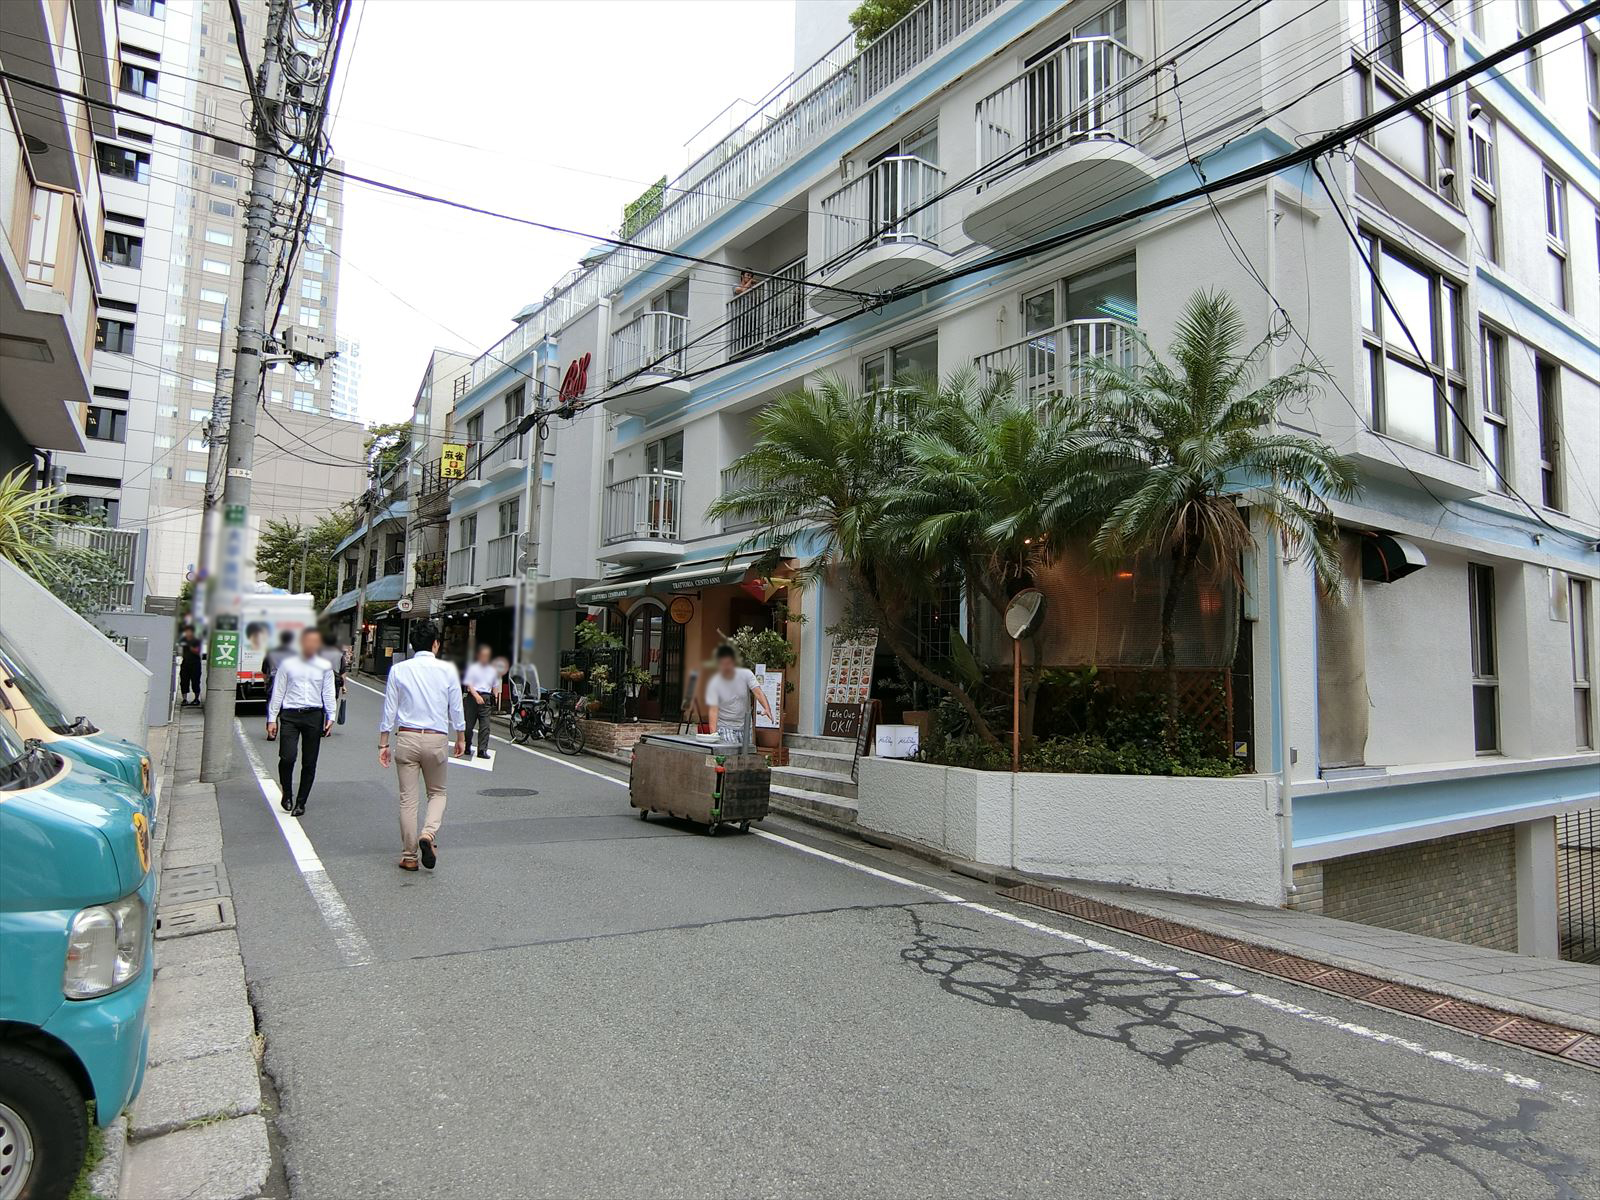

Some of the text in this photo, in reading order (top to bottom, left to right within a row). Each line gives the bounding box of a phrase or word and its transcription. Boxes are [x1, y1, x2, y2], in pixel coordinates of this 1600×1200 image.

[444, 450, 465, 461] 麻雀
[828, 708, 856, 720] Take Out
[830, 719, 853, 733] OK!!
